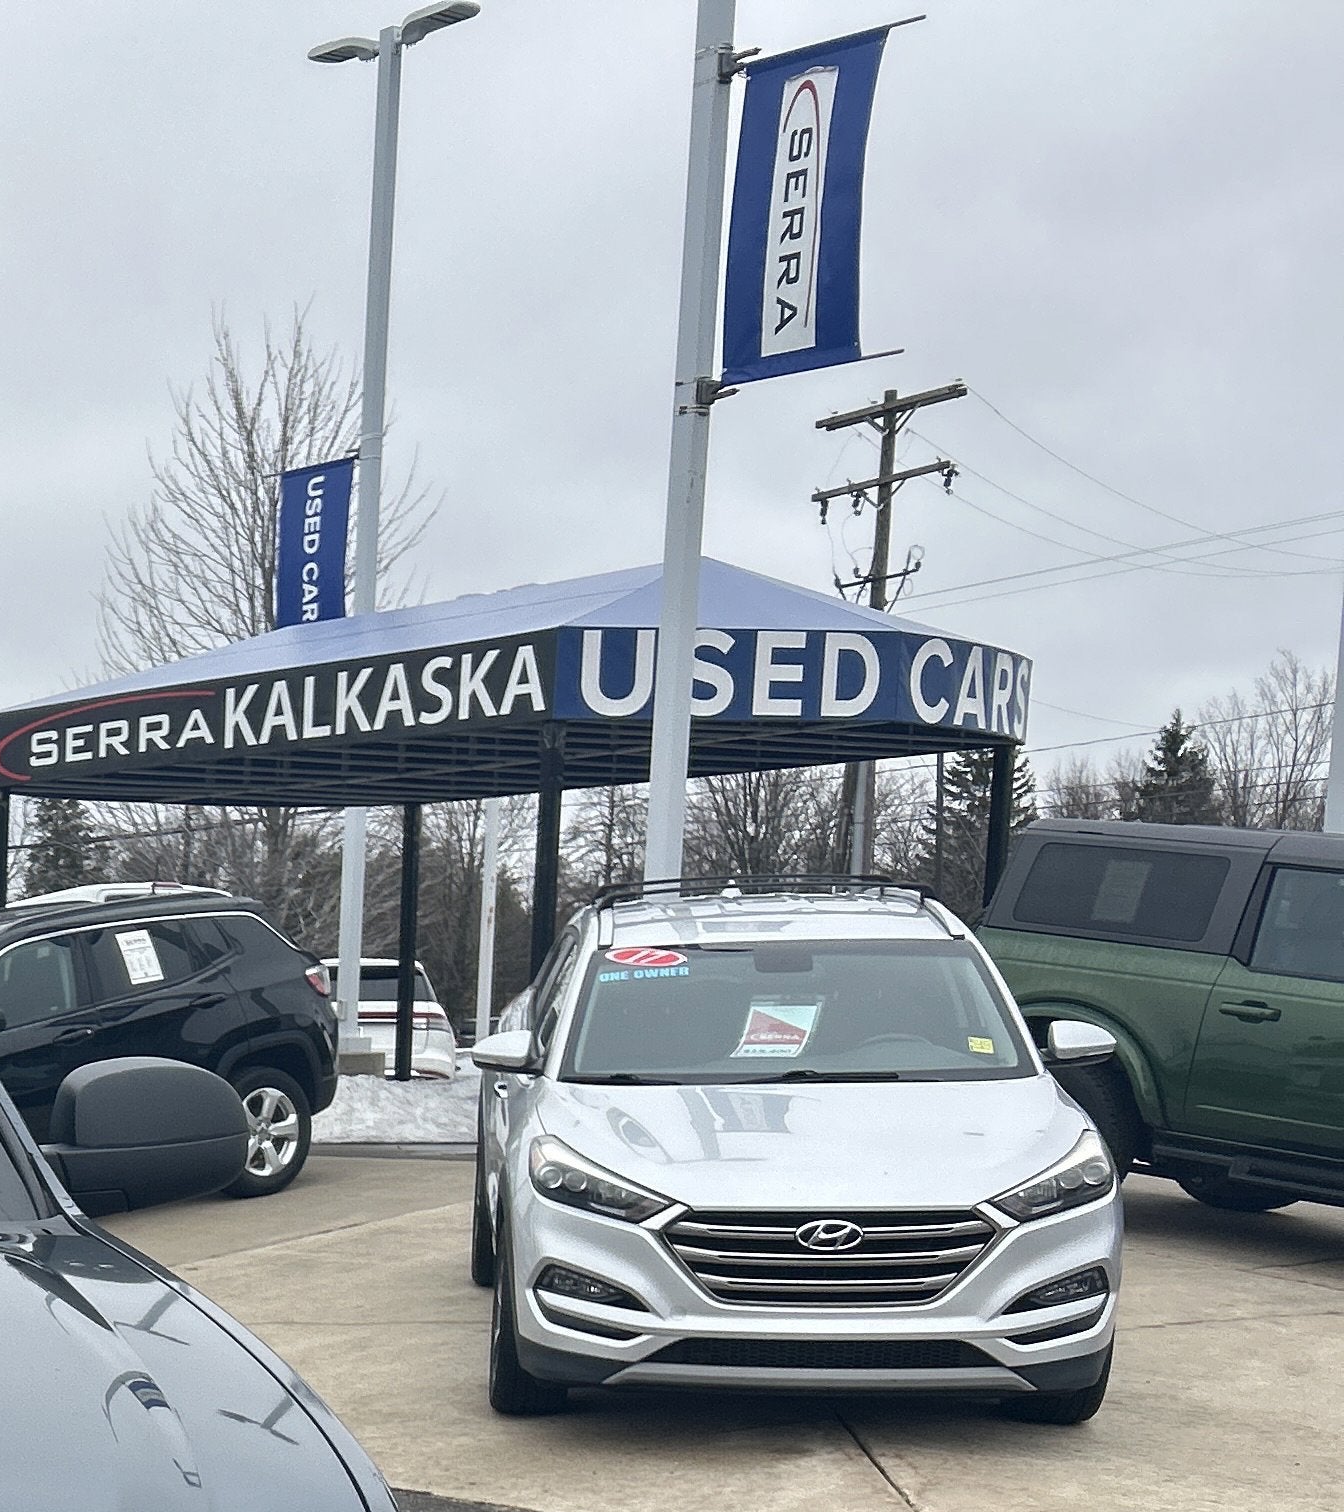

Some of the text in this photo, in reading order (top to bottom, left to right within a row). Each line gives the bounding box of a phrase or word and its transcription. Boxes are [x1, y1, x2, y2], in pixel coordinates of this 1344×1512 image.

[774, 127, 813, 336] SERRA
[302, 475, 326, 555] USED
[28, 629, 1031, 768] SERRA KALKASKA USED CARS
[599, 967, 690, 982] ONE OWNER
